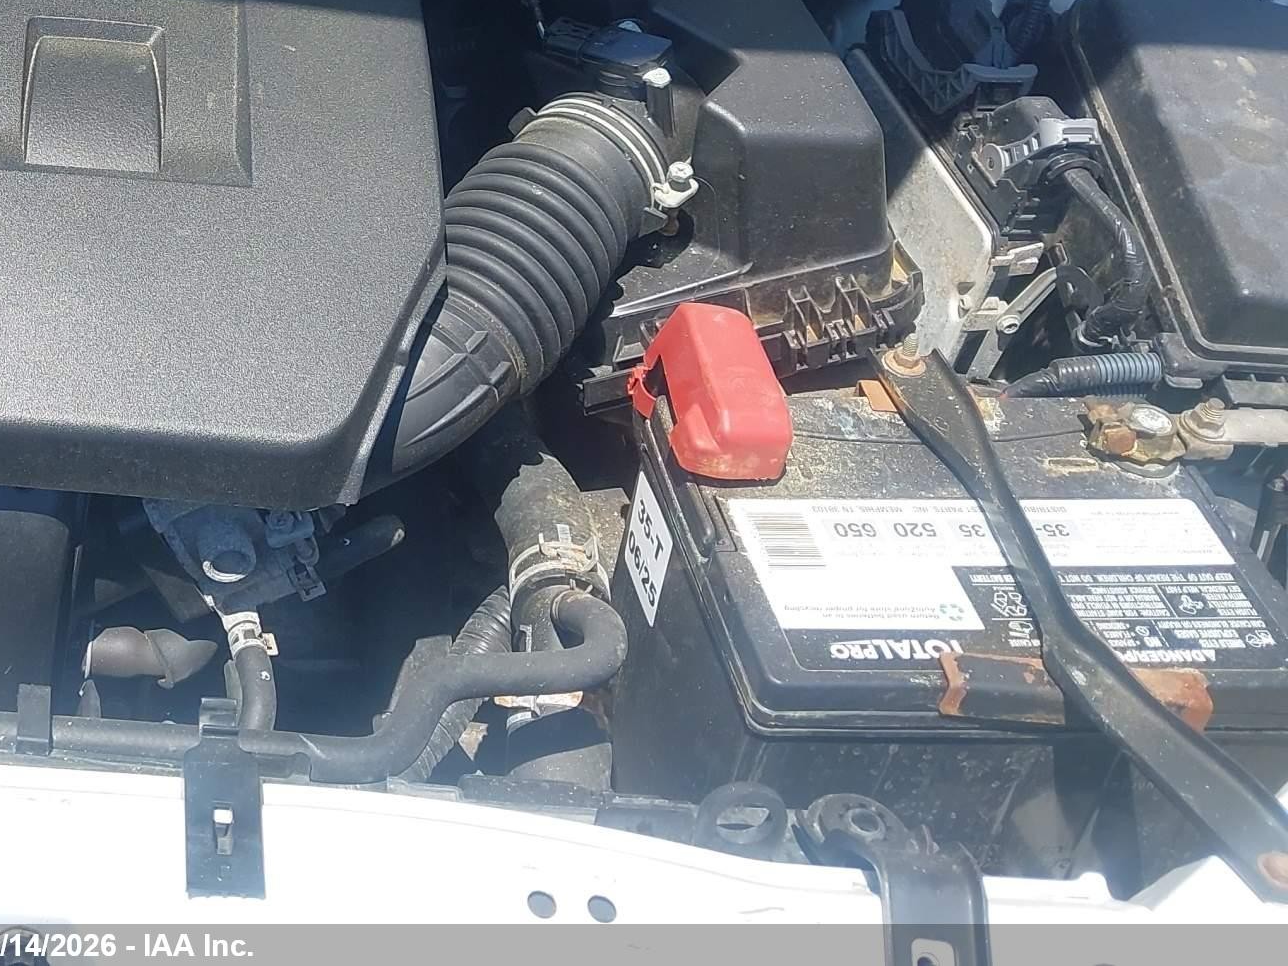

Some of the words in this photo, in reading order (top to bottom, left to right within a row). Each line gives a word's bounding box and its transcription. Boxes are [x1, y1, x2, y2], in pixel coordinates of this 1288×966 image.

[638, 500, 664, 561] 35-T
[834, 523, 877, 537] 650
[893, 523, 936, 537] 520
[958, 524, 985, 537] 35
[1034, 523, 1070, 538] 35-
[628, 530, 658, 608] 06/25
[1143, 637, 1162, 647] NO
[829, 639, 965, 660] TOTALPRO
